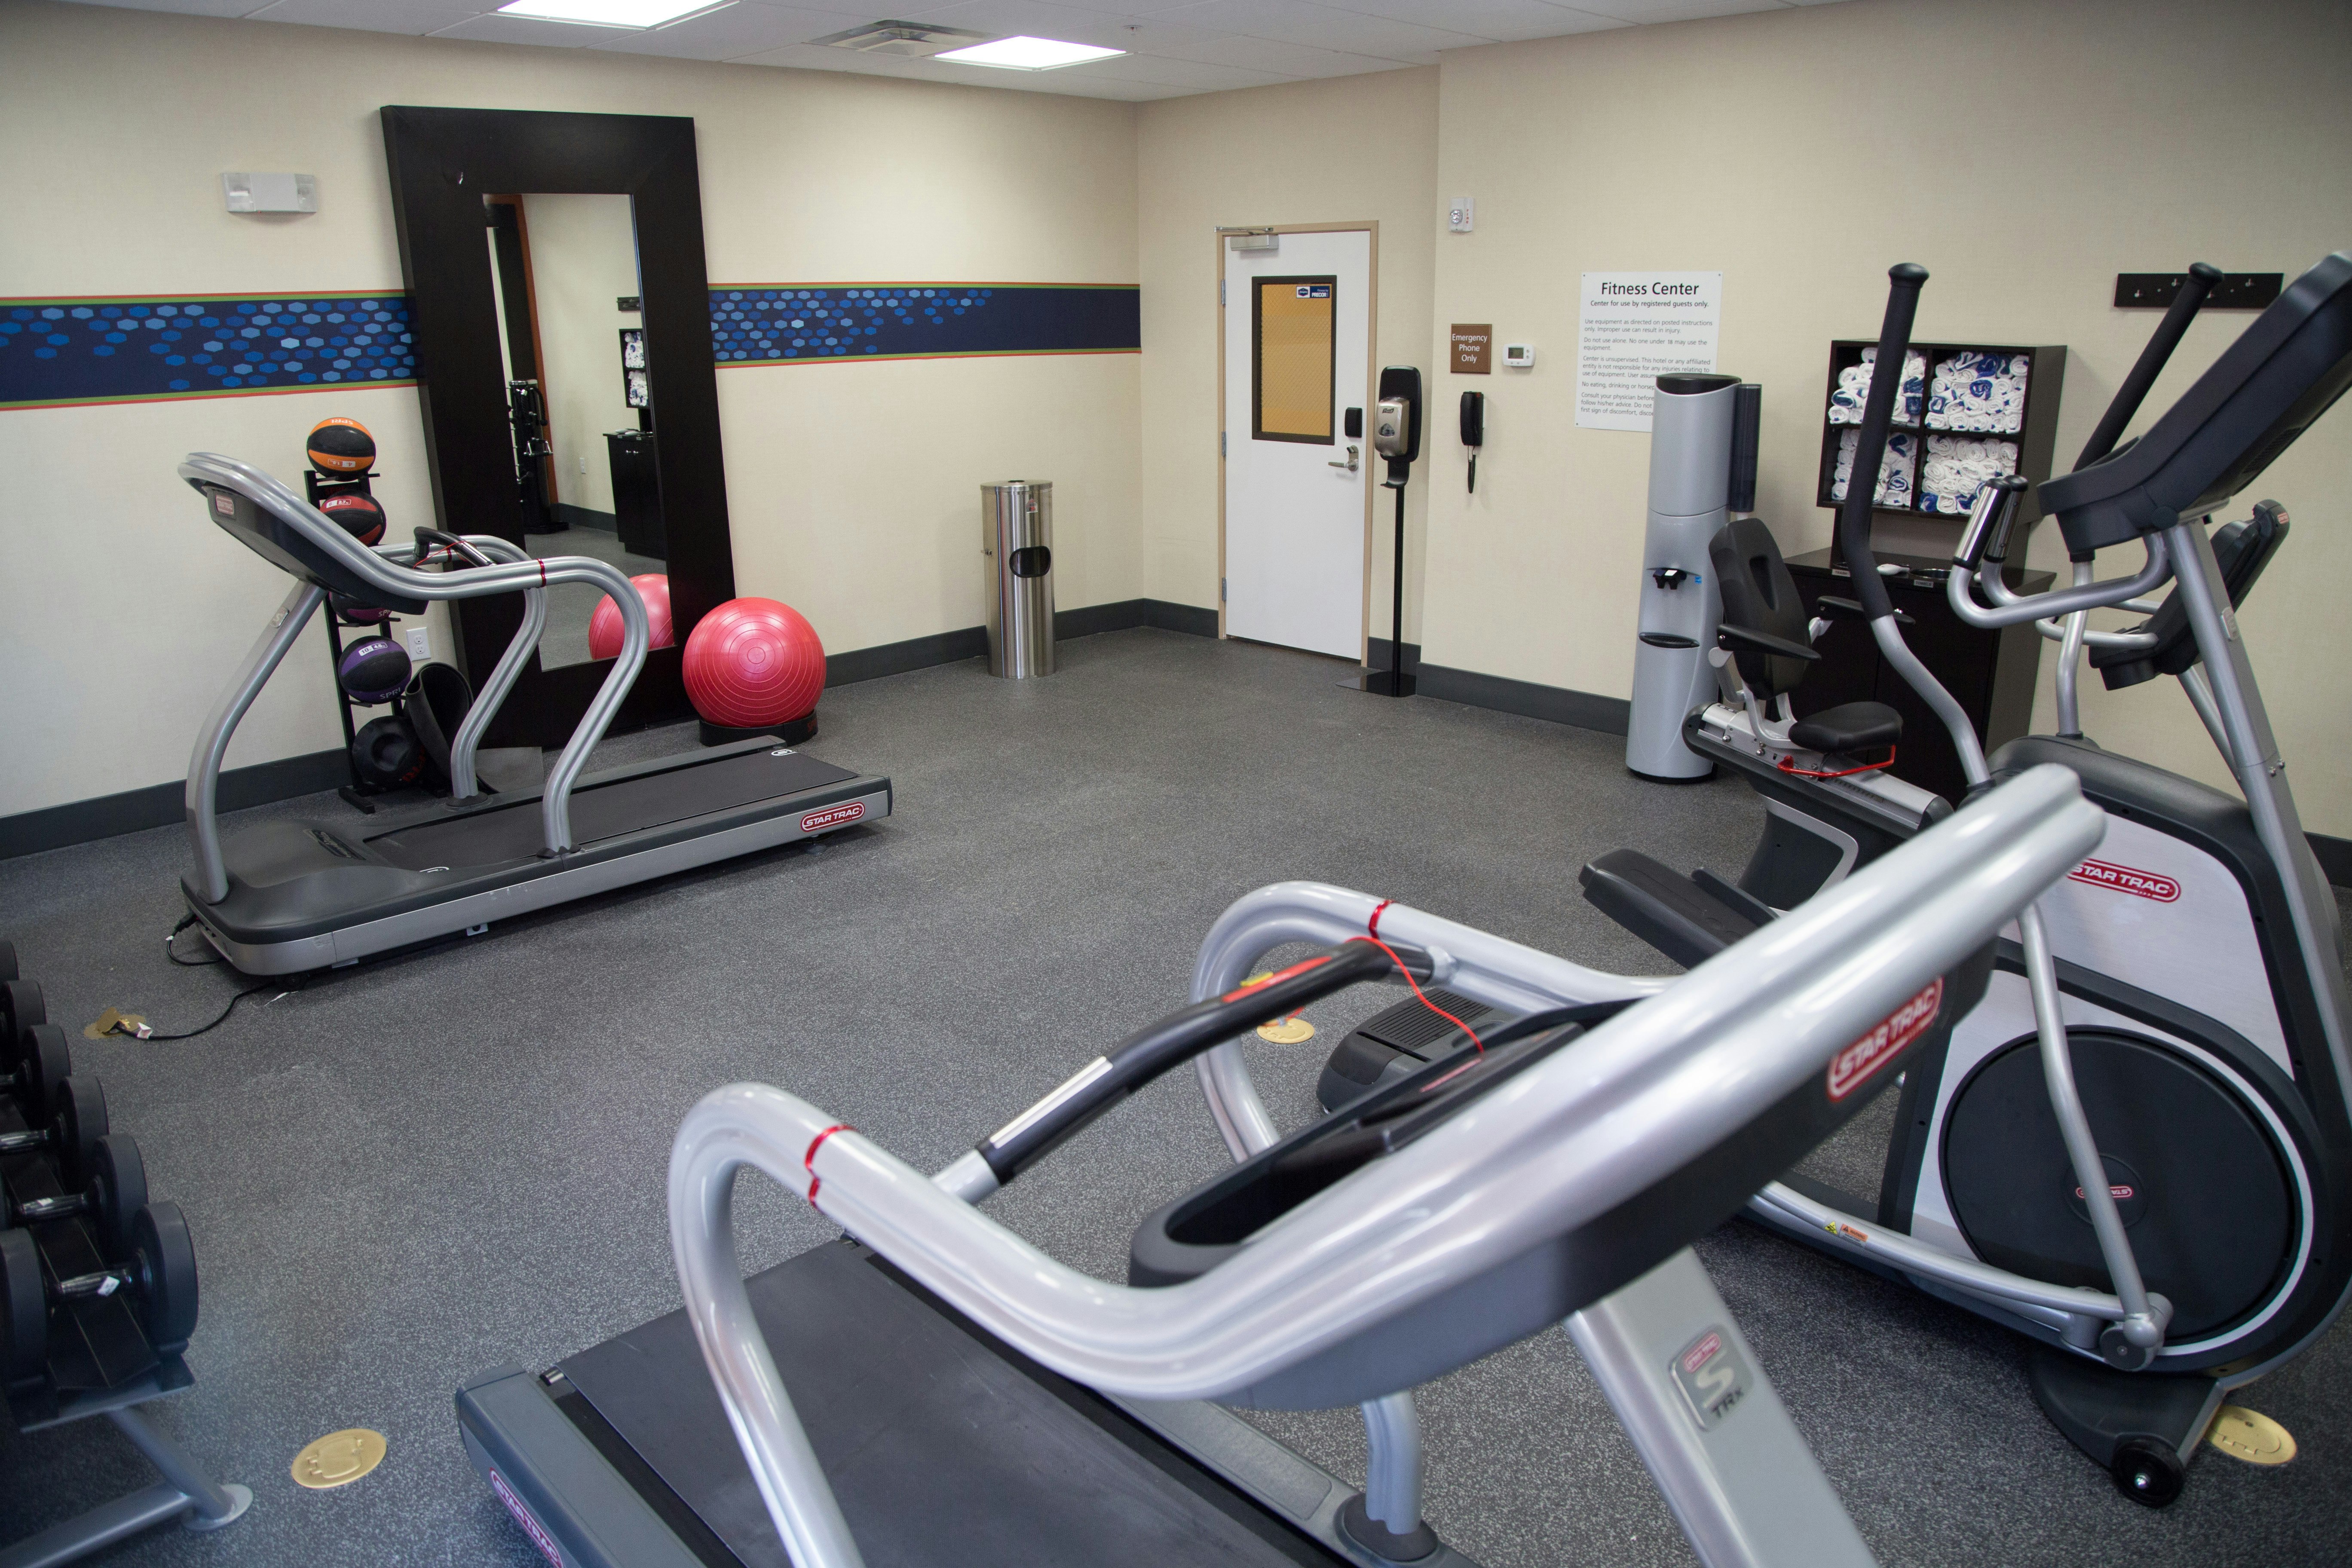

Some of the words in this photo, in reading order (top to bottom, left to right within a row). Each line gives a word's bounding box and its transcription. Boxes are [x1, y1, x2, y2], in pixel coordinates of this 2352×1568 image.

[1602, 282, 1647, 295] Fitness
[1652, 282, 1699, 295] Center
[1694, 300, 1709, 309] only.
[1452, 334, 1488, 343] Emergency
[1461, 354, 1477, 364] Only
[380, 687, 401, 699] SPRI
[806, 815, 832, 826] STAR
[833, 807, 860, 820] TRAC
[2072, 864, 2117, 882] STAR
[2119, 874, 2170, 894] TRAC
[1839, 1025, 1890, 1077] STAR
[1890, 986, 1935, 1039] TRAC
[494, 1480, 524, 1521] STAR
[524, 1515, 559, 1562] TRAC
